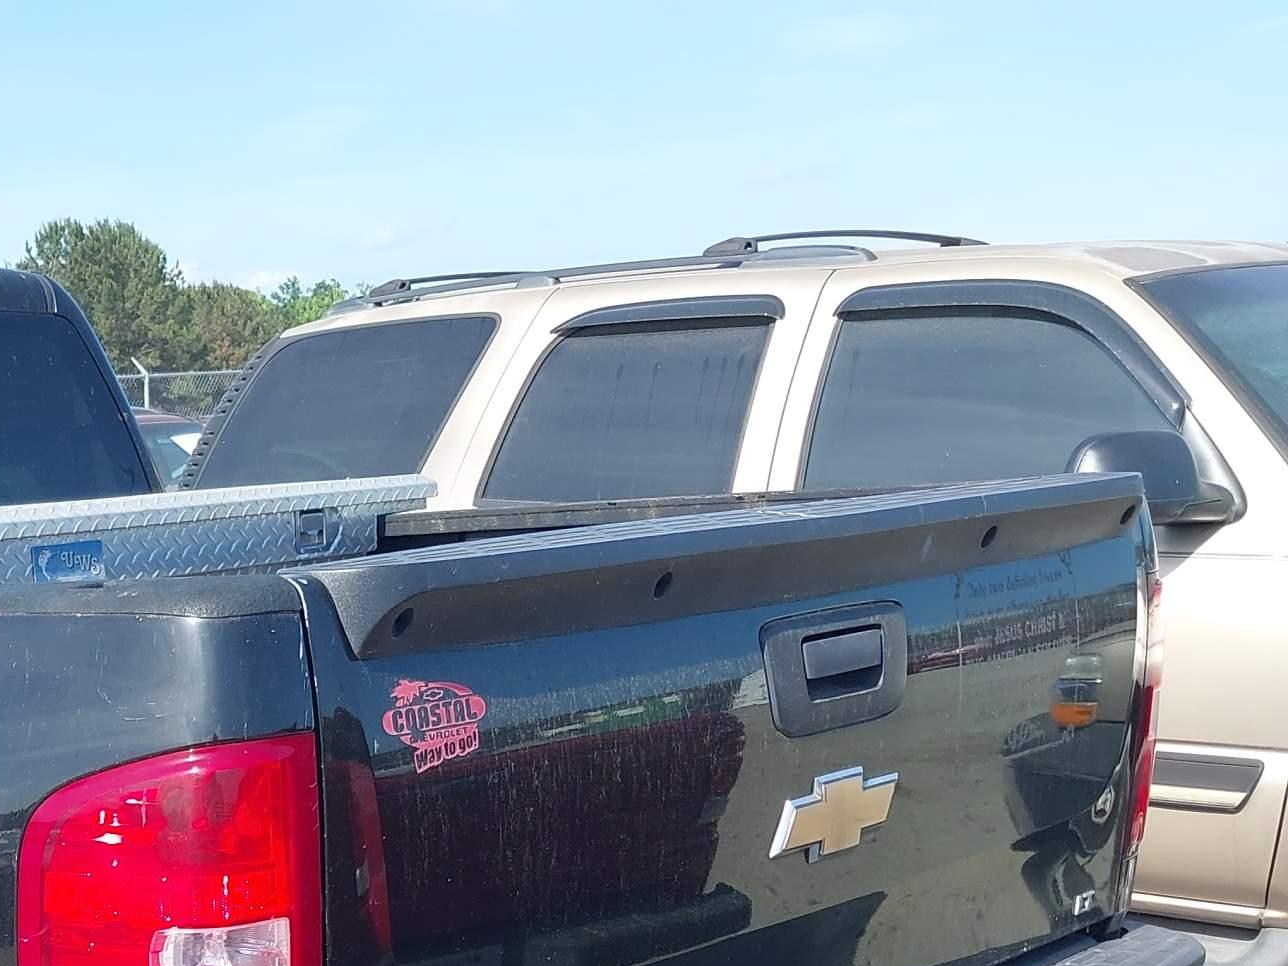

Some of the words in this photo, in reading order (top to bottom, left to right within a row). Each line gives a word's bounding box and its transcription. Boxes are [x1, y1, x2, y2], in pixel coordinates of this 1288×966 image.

[392, 697, 478, 734] COASTAL
[409, 726, 467, 744] CEVROLET
[415, 745, 443, 770] Way
[444, 741, 456, 758] to
[458, 730, 477, 754] go!
